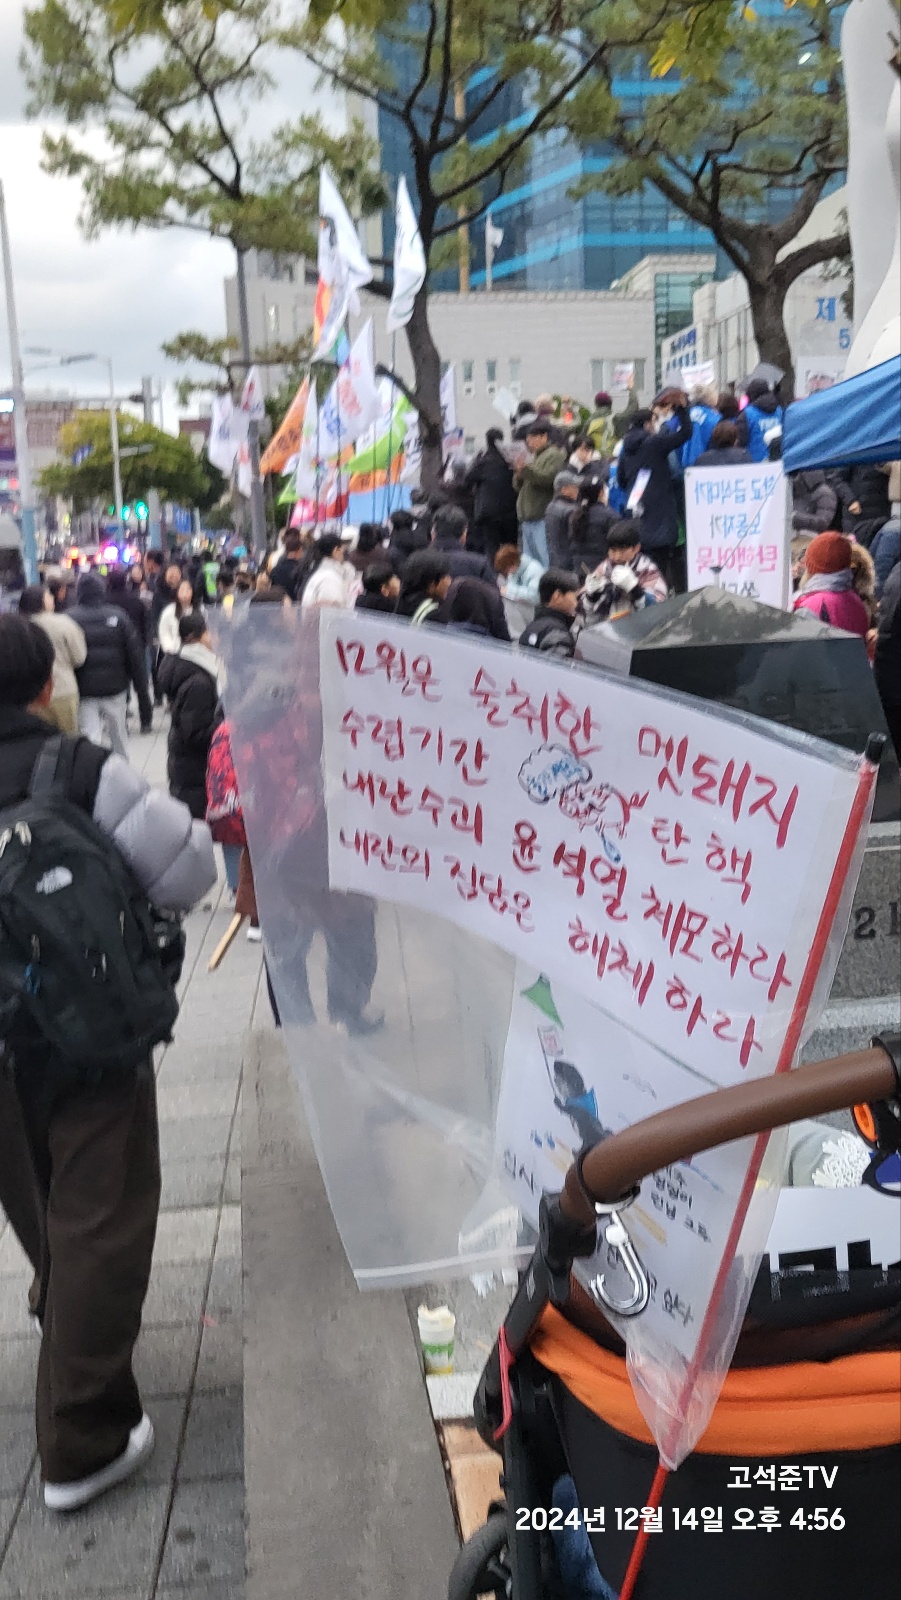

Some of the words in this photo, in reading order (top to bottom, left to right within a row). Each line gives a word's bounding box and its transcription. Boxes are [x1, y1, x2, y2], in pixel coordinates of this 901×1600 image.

[335, 635, 443, 702] 12월은
[469, 665, 602, 757] 술취한
[340, 706, 489, 788] 수렵기간
[338, 827, 431, 883] 내란의
